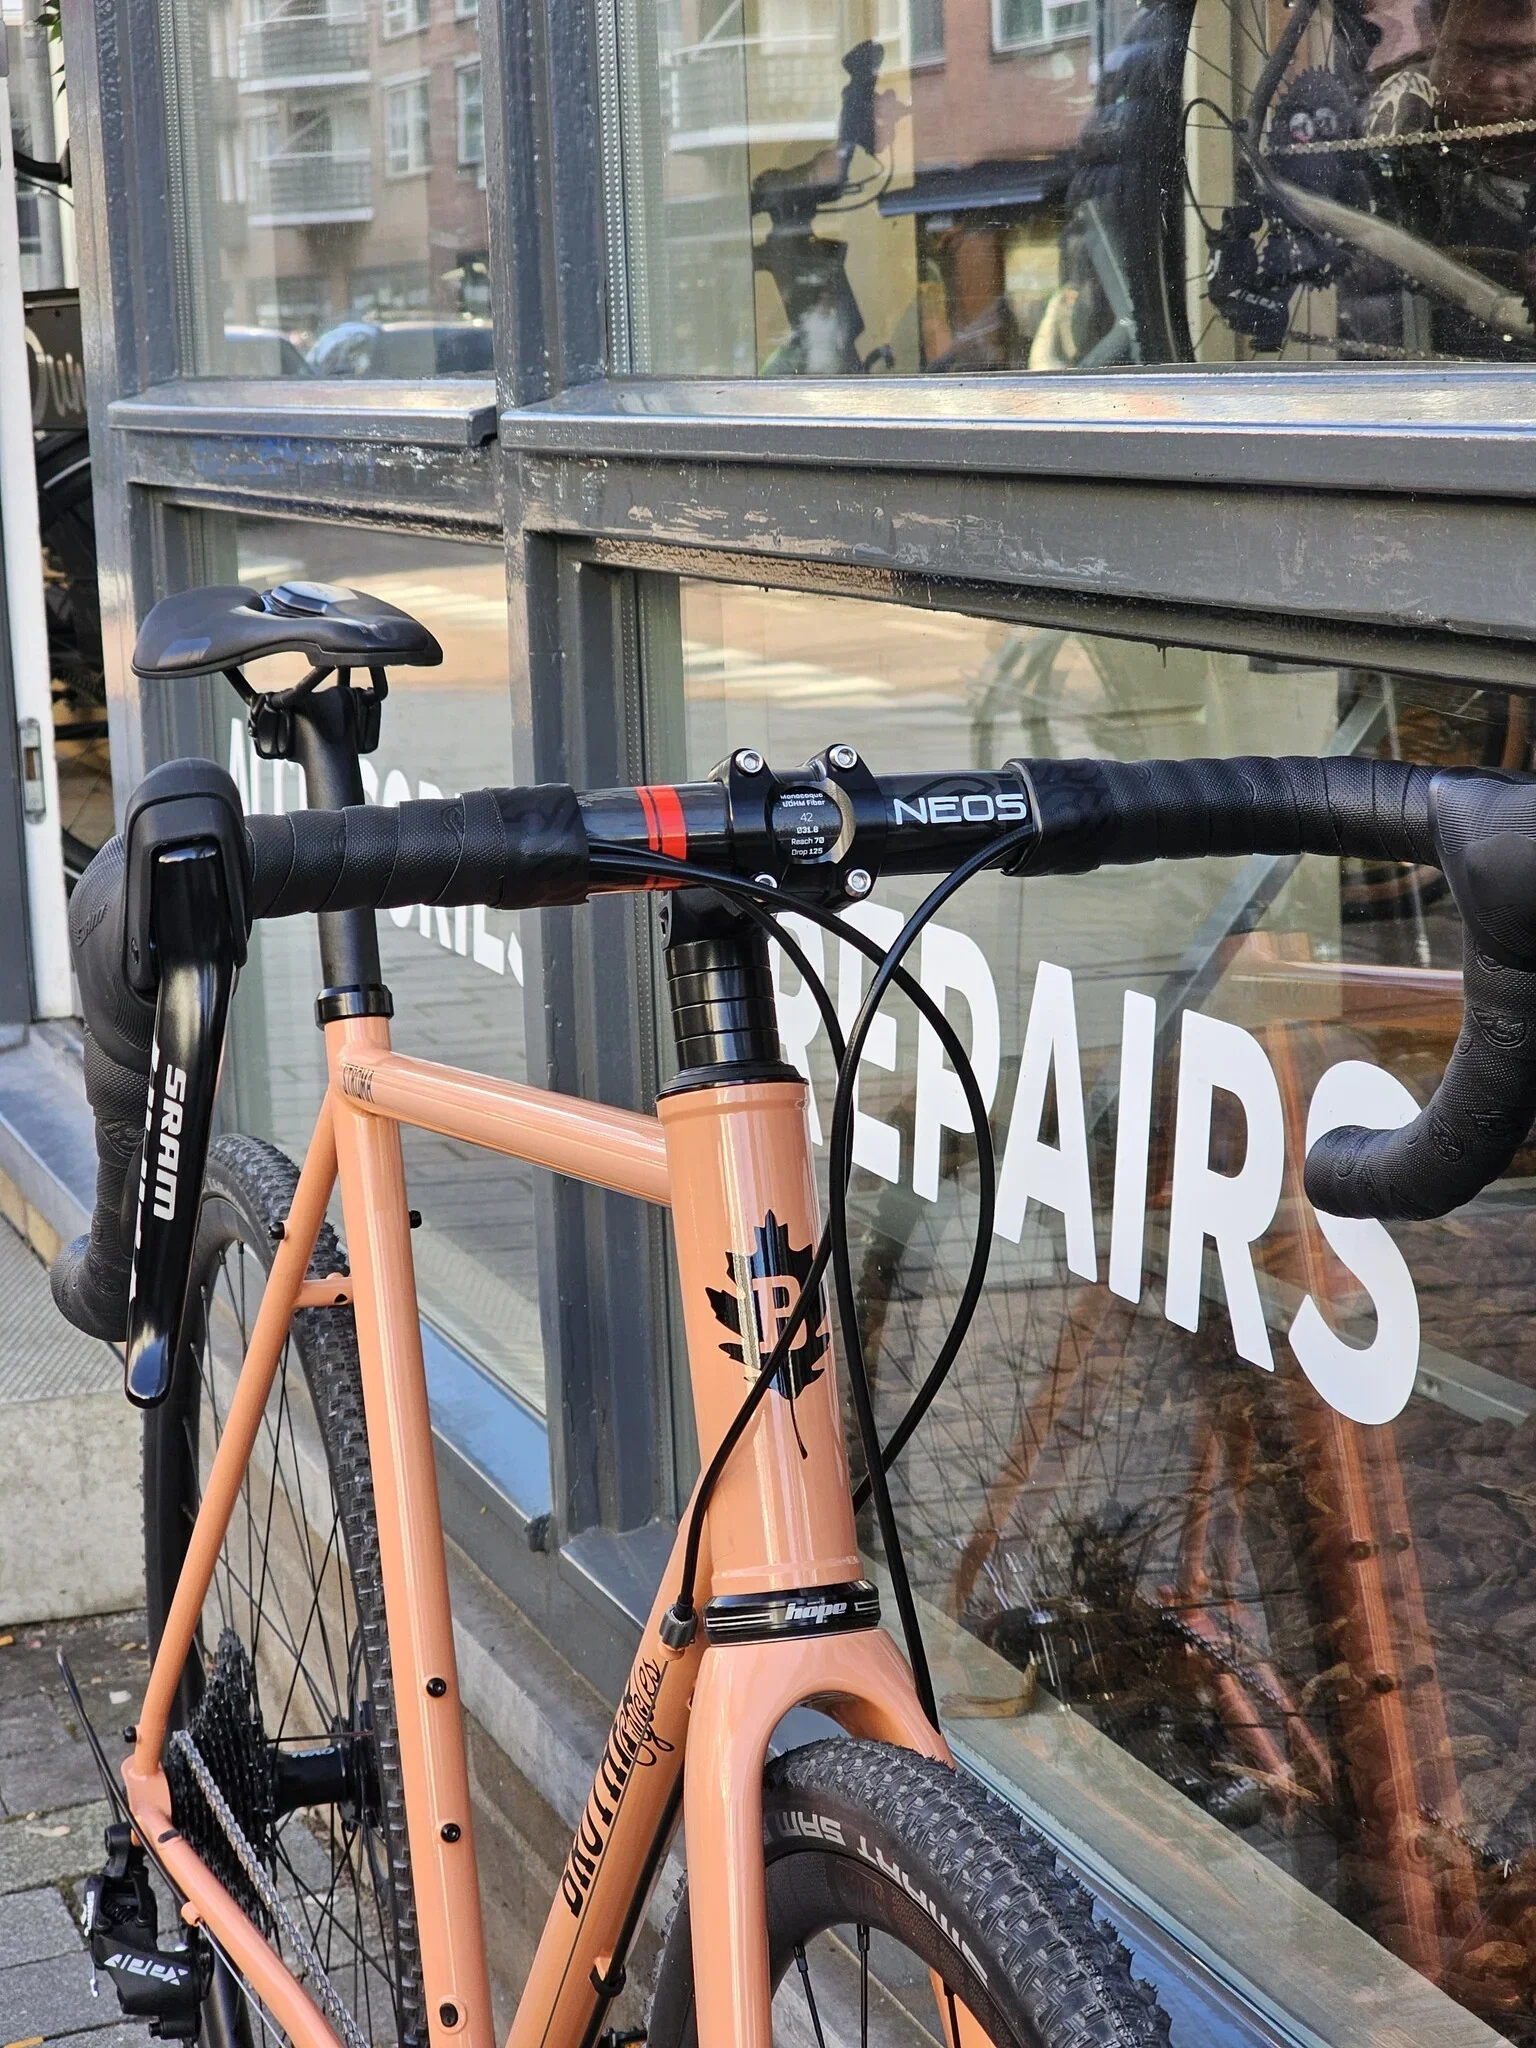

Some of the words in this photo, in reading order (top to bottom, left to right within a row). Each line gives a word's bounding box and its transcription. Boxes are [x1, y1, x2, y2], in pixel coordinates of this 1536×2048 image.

[800, 812, 813, 822] 42
[893, 793, 1027, 825] NEOS
[791, 837, 813, 845] Reach
[814, 836, 825, 844] 70
[791, 849, 808, 857] Drop
[809, 847, 823, 855] 125
[153, 1063, 188, 1222] SRAM
[767, 900, 1421, 1425] REPAIRS
[784, 1602, 848, 1624] hope
[775, 1811, 847, 1847] SAM
[857, 1835, 989, 1989] SMART
